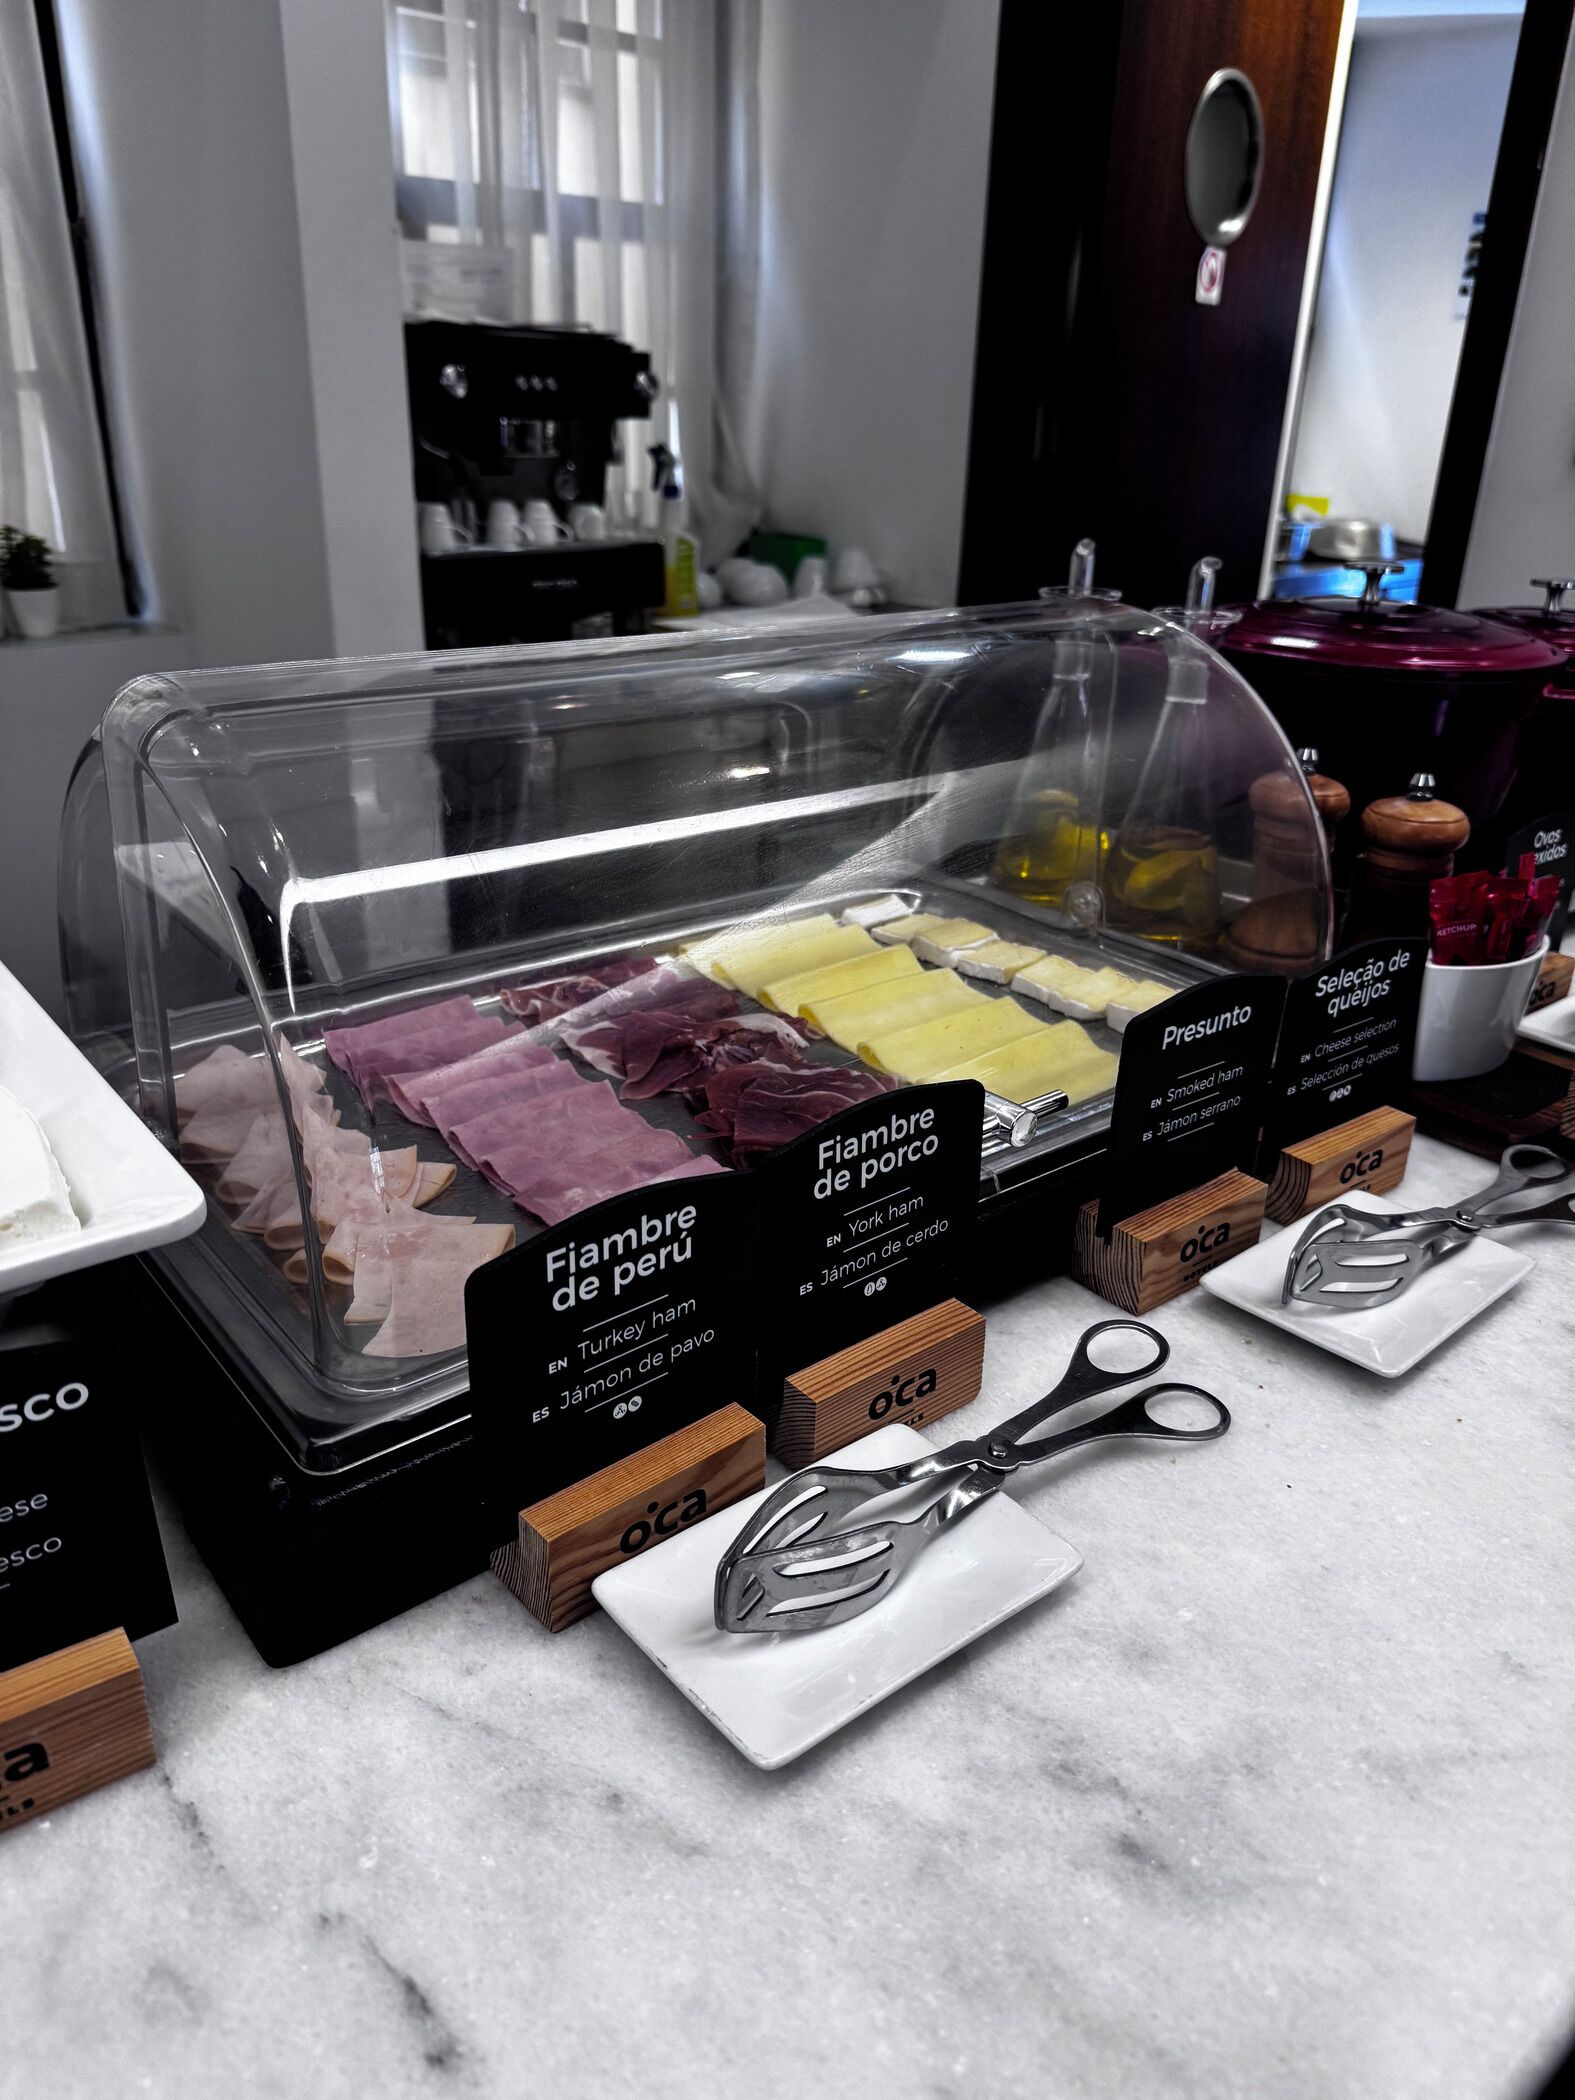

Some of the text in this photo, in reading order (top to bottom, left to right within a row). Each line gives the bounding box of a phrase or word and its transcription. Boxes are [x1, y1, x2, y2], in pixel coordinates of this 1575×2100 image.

[1534, 829, 1561, 848] Ovos
[1436, 923, 1477, 937] KETCHUP
[1315, 949, 1411, 998] Seleção de
[1327, 979, 1392, 1018] queijos
[1162, 1005, 1252, 1050] Presunto
[1300, 1018, 1398, 1064] EN Cheese selection
[1150, 1066, 1244, 1109] EN Smoked ham
[1287, 1043, 1400, 1095] ES Selección de quesos
[818, 1108, 935, 1170] Fiambre
[1142, 1095, 1242, 1142] ES Jámon serrano
[813, 1135, 939, 1200] de porco
[546, 1205, 697, 1283] Fiambre
[826, 1196, 924, 1248] EN York ham
[552, 1231, 693, 1312] de perú
[799, 1218, 949, 1296] ES Jámon de cerdo
[548, 1298, 696, 1374] EN Turkey ham
[532, 1329, 715, 1423] ES Jámon de pavo
